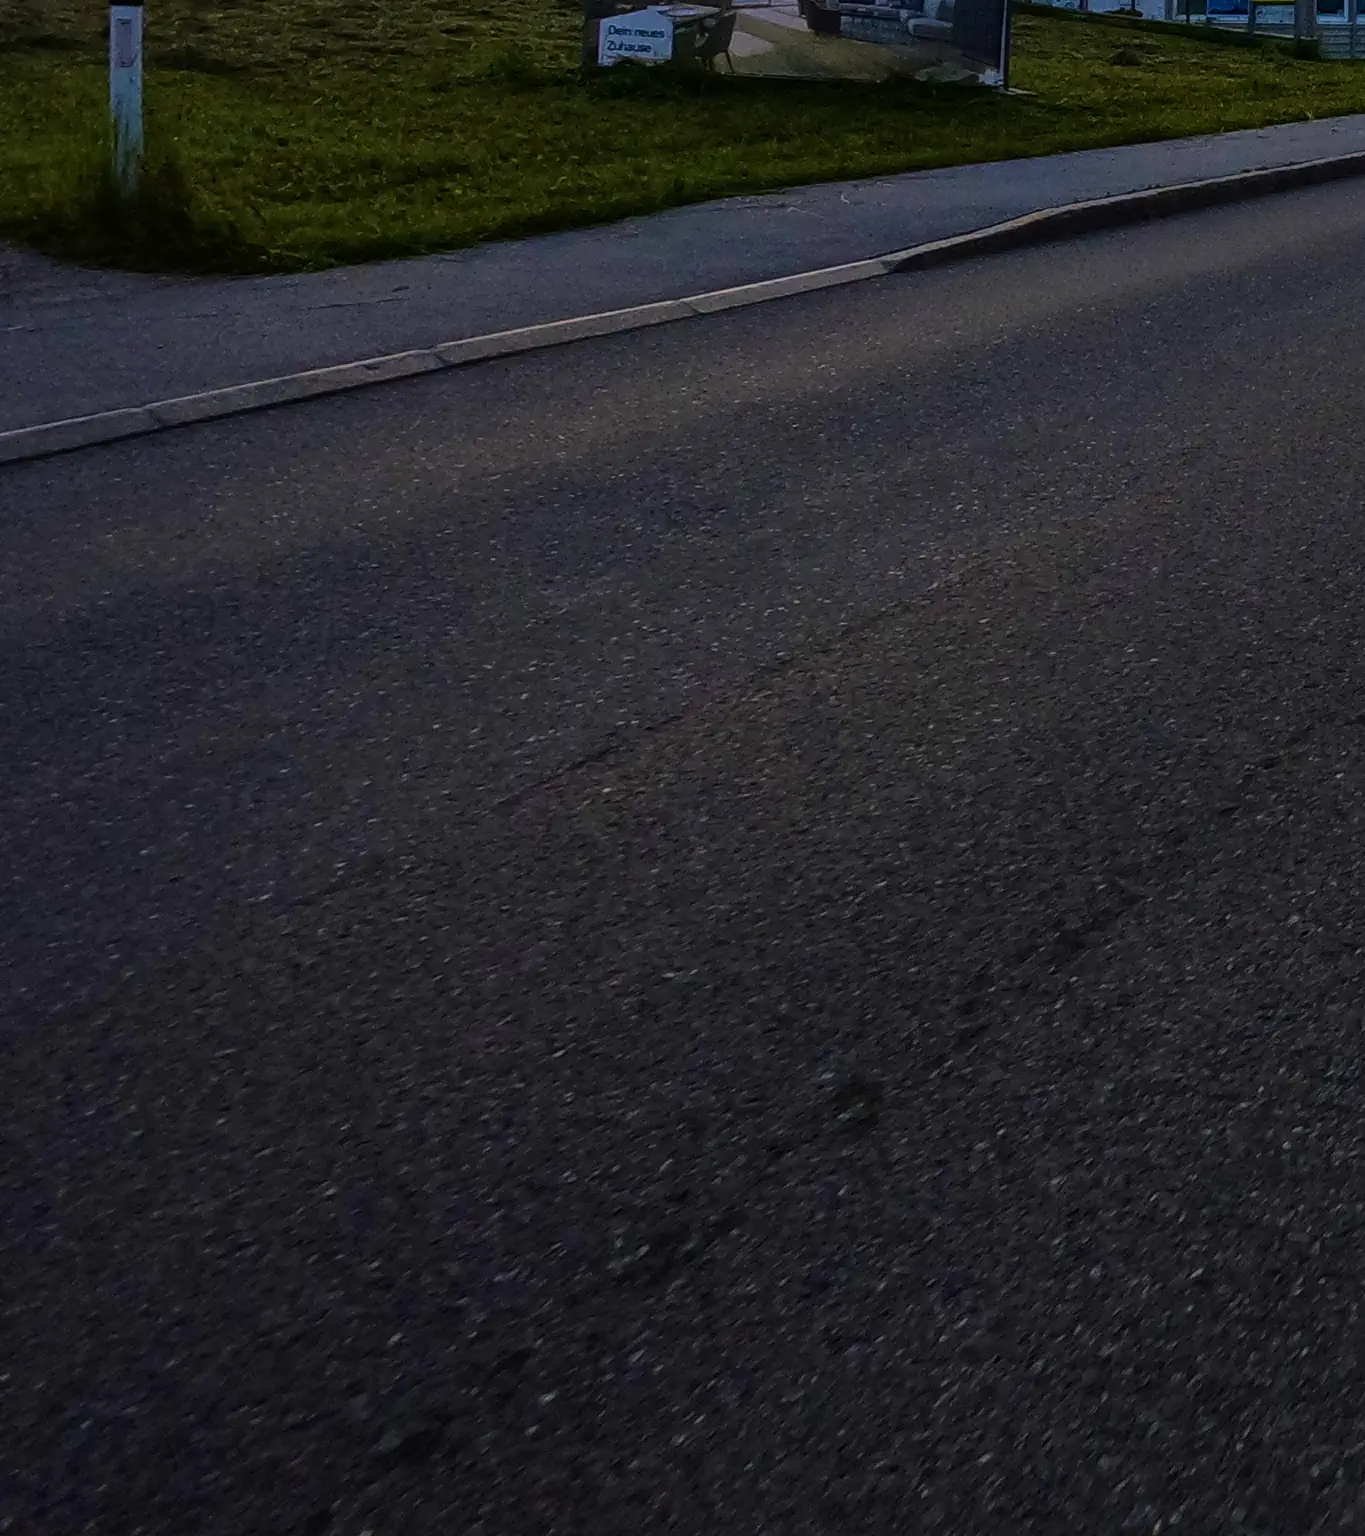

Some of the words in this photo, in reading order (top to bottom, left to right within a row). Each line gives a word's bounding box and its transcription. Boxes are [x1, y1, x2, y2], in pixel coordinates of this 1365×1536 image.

[608, 24, 632, 36] Dein
[634, 28, 665, 39] neues
[606, 40, 653, 53] Zuhause
